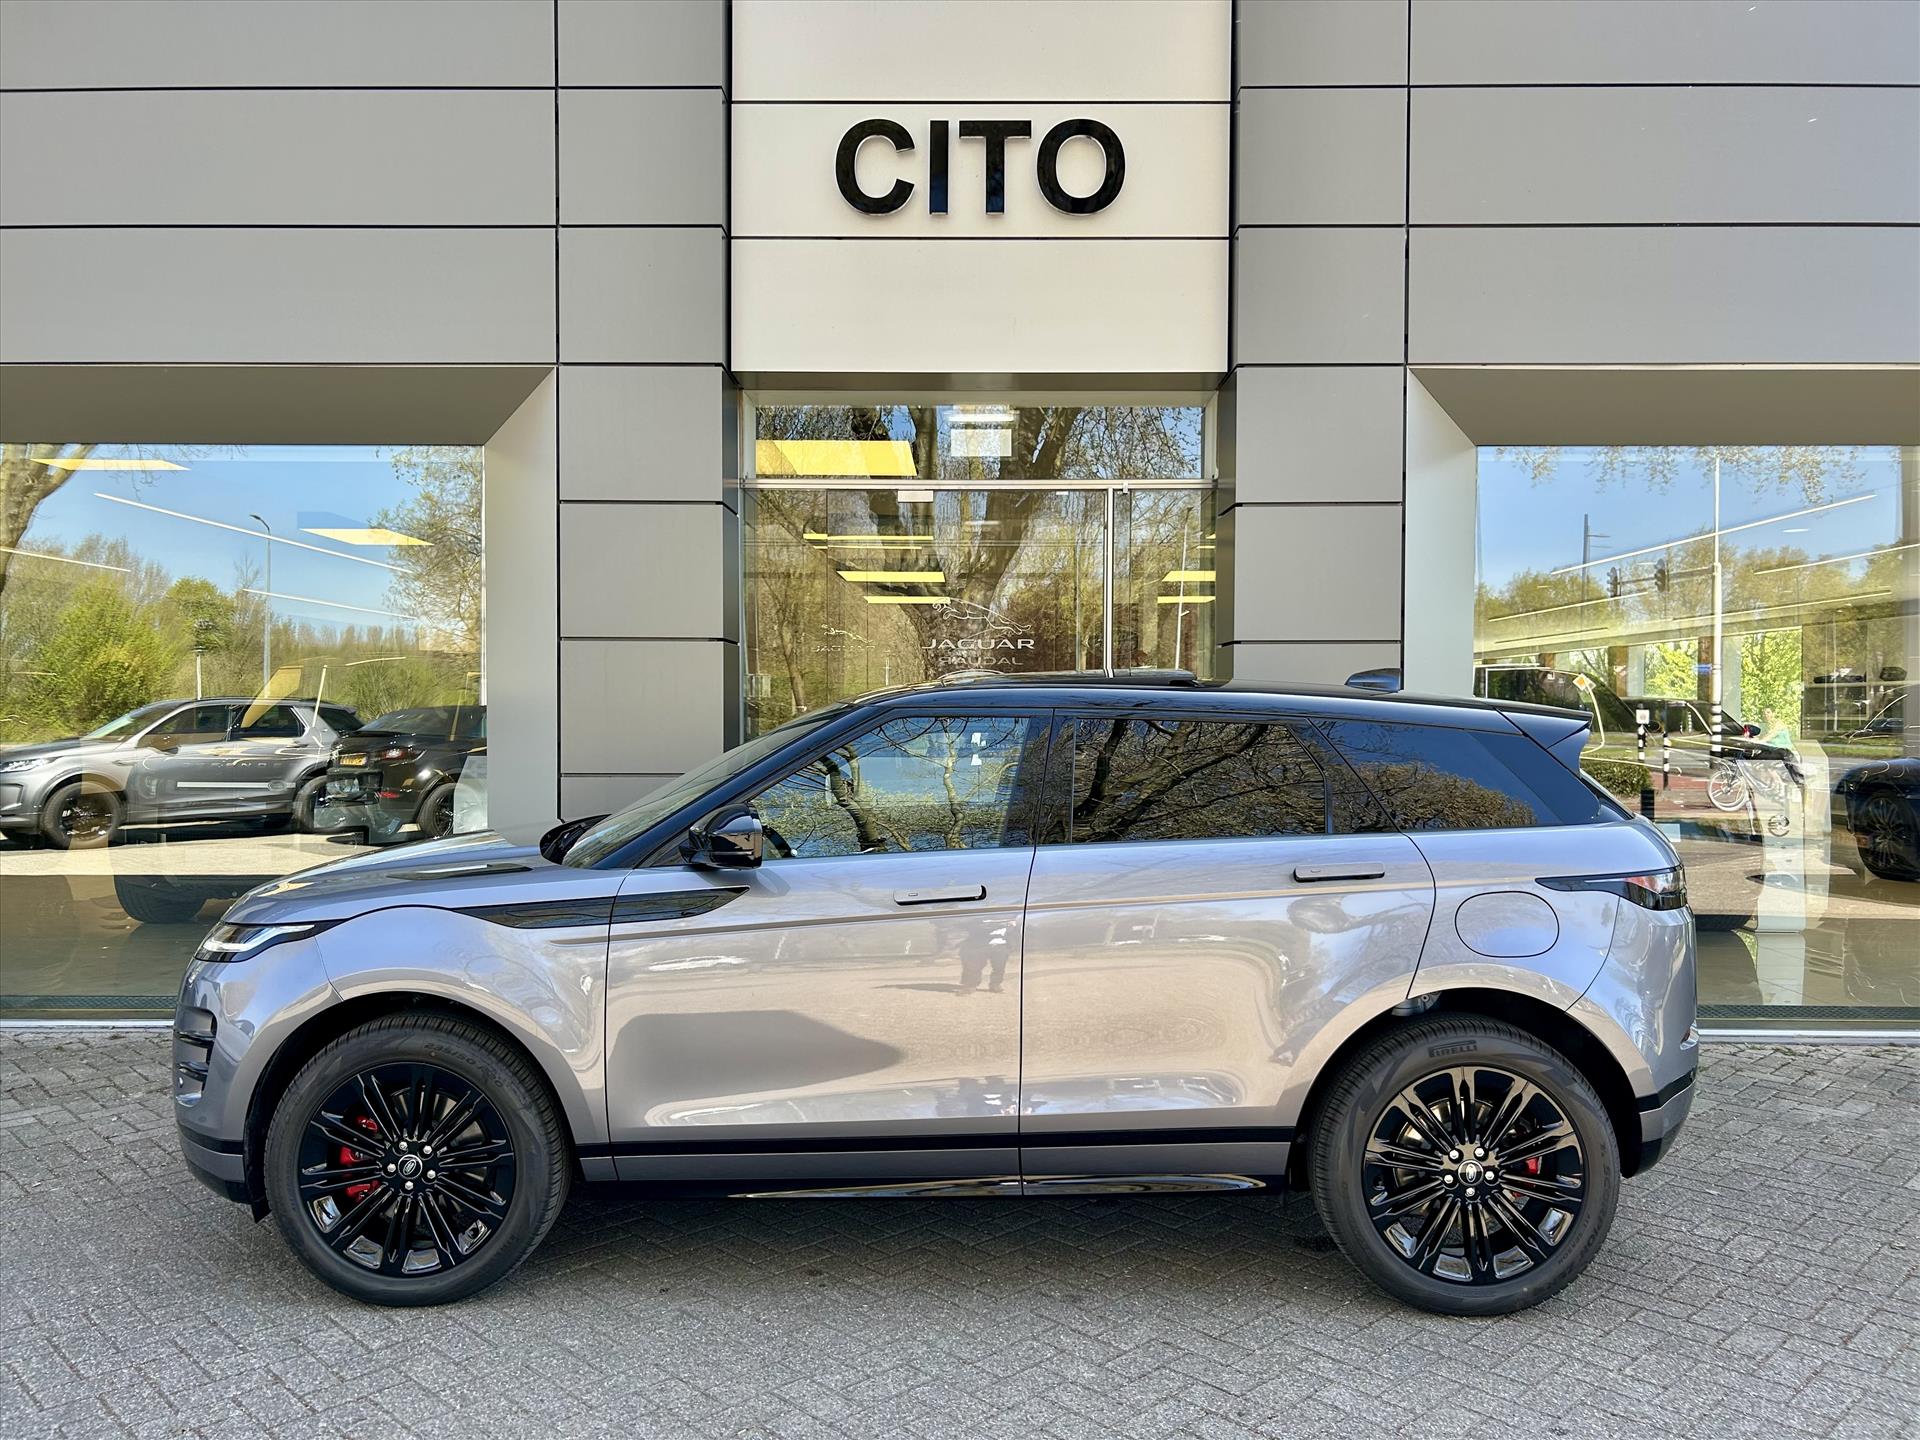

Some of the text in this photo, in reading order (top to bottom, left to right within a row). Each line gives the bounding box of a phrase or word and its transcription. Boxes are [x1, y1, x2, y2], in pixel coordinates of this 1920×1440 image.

[835, 118, 1127, 216] CITO
[922, 638, 1036, 650] JAGUAR
[1428, 1040, 1478, 1058] PIRELLI
